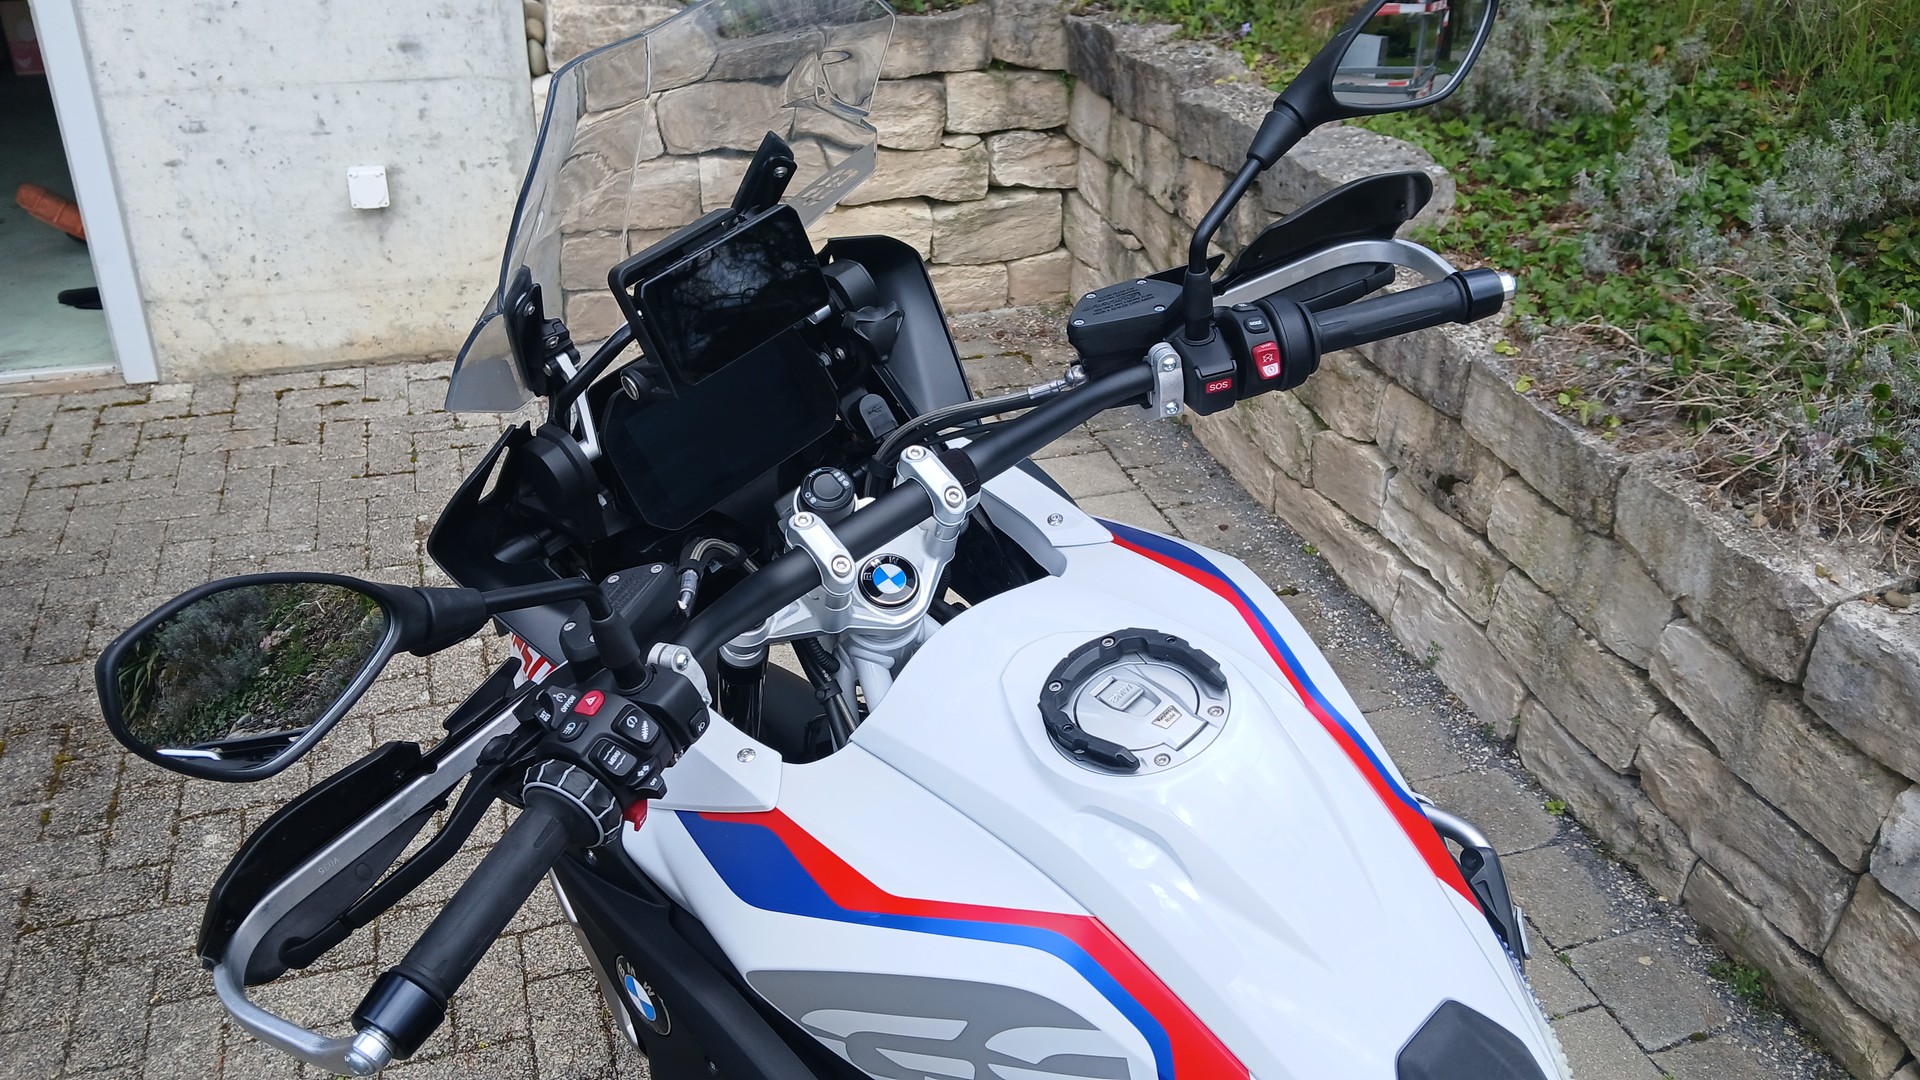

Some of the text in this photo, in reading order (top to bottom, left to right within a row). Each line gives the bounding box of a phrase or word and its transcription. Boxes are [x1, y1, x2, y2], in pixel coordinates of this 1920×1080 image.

[1209, 381, 1229, 391] SOS
[560, 694, 576, 713] OFF/ON
[607, 750, 621, 766] MENU
[649, 777, 658, 787] OFF
[617, 961, 656, 997] BMW
